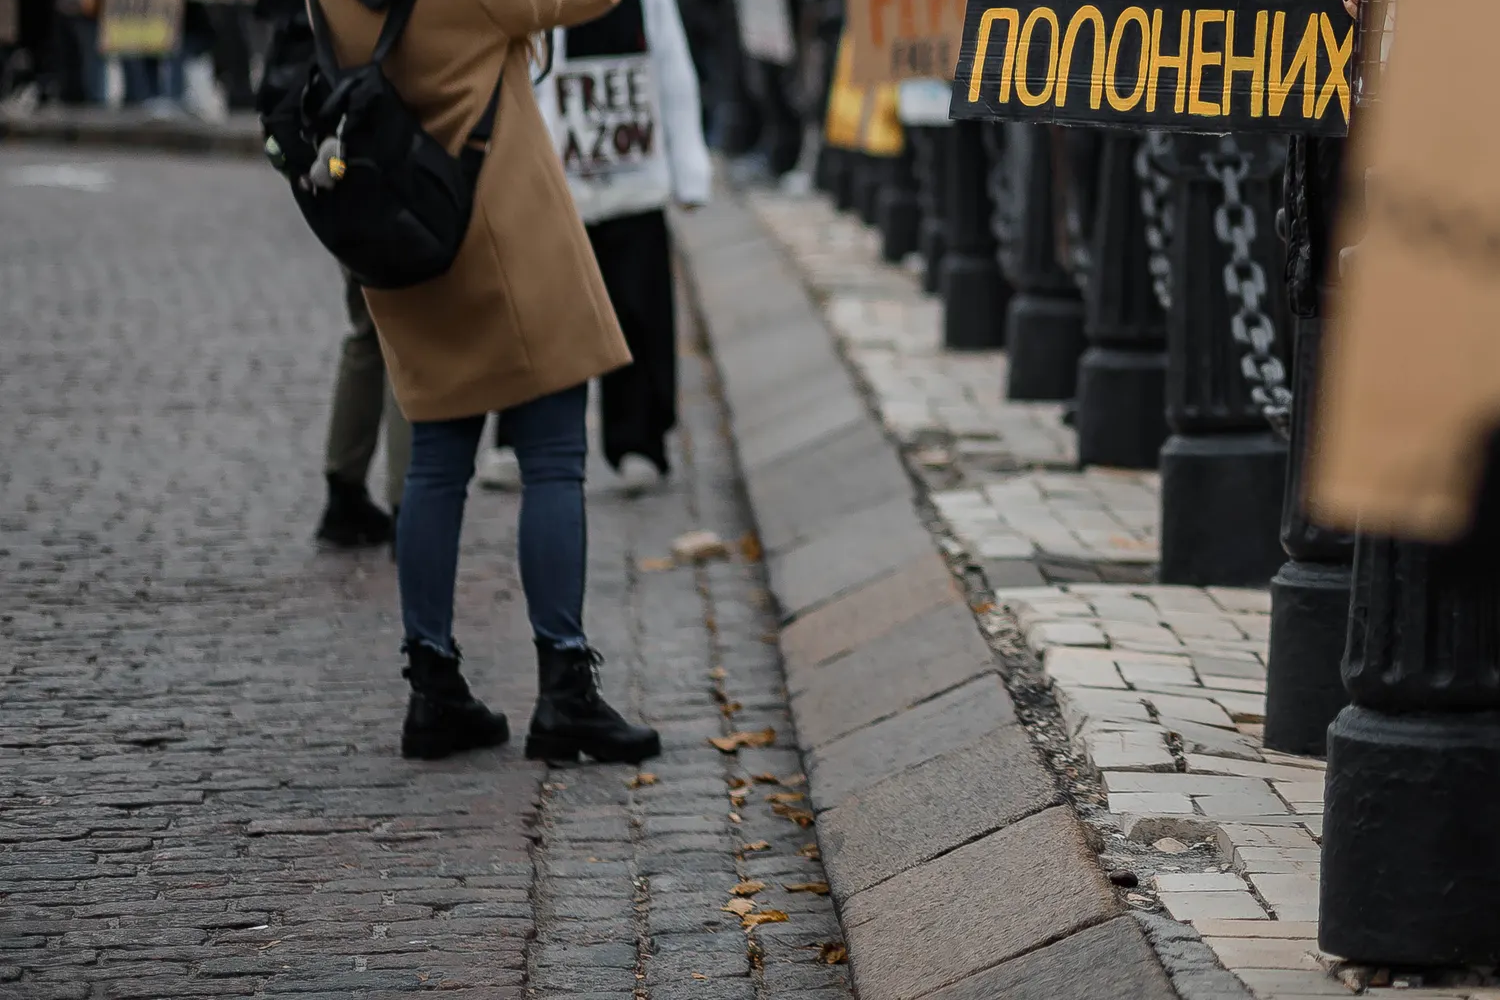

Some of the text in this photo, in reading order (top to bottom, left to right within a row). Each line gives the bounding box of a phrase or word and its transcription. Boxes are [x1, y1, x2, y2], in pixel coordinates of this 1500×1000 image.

[967, 4, 1354, 125] ПОЛОНЕНИХ
[555, 66, 649, 117] FREE
[564, 119, 654, 168] AZOV
